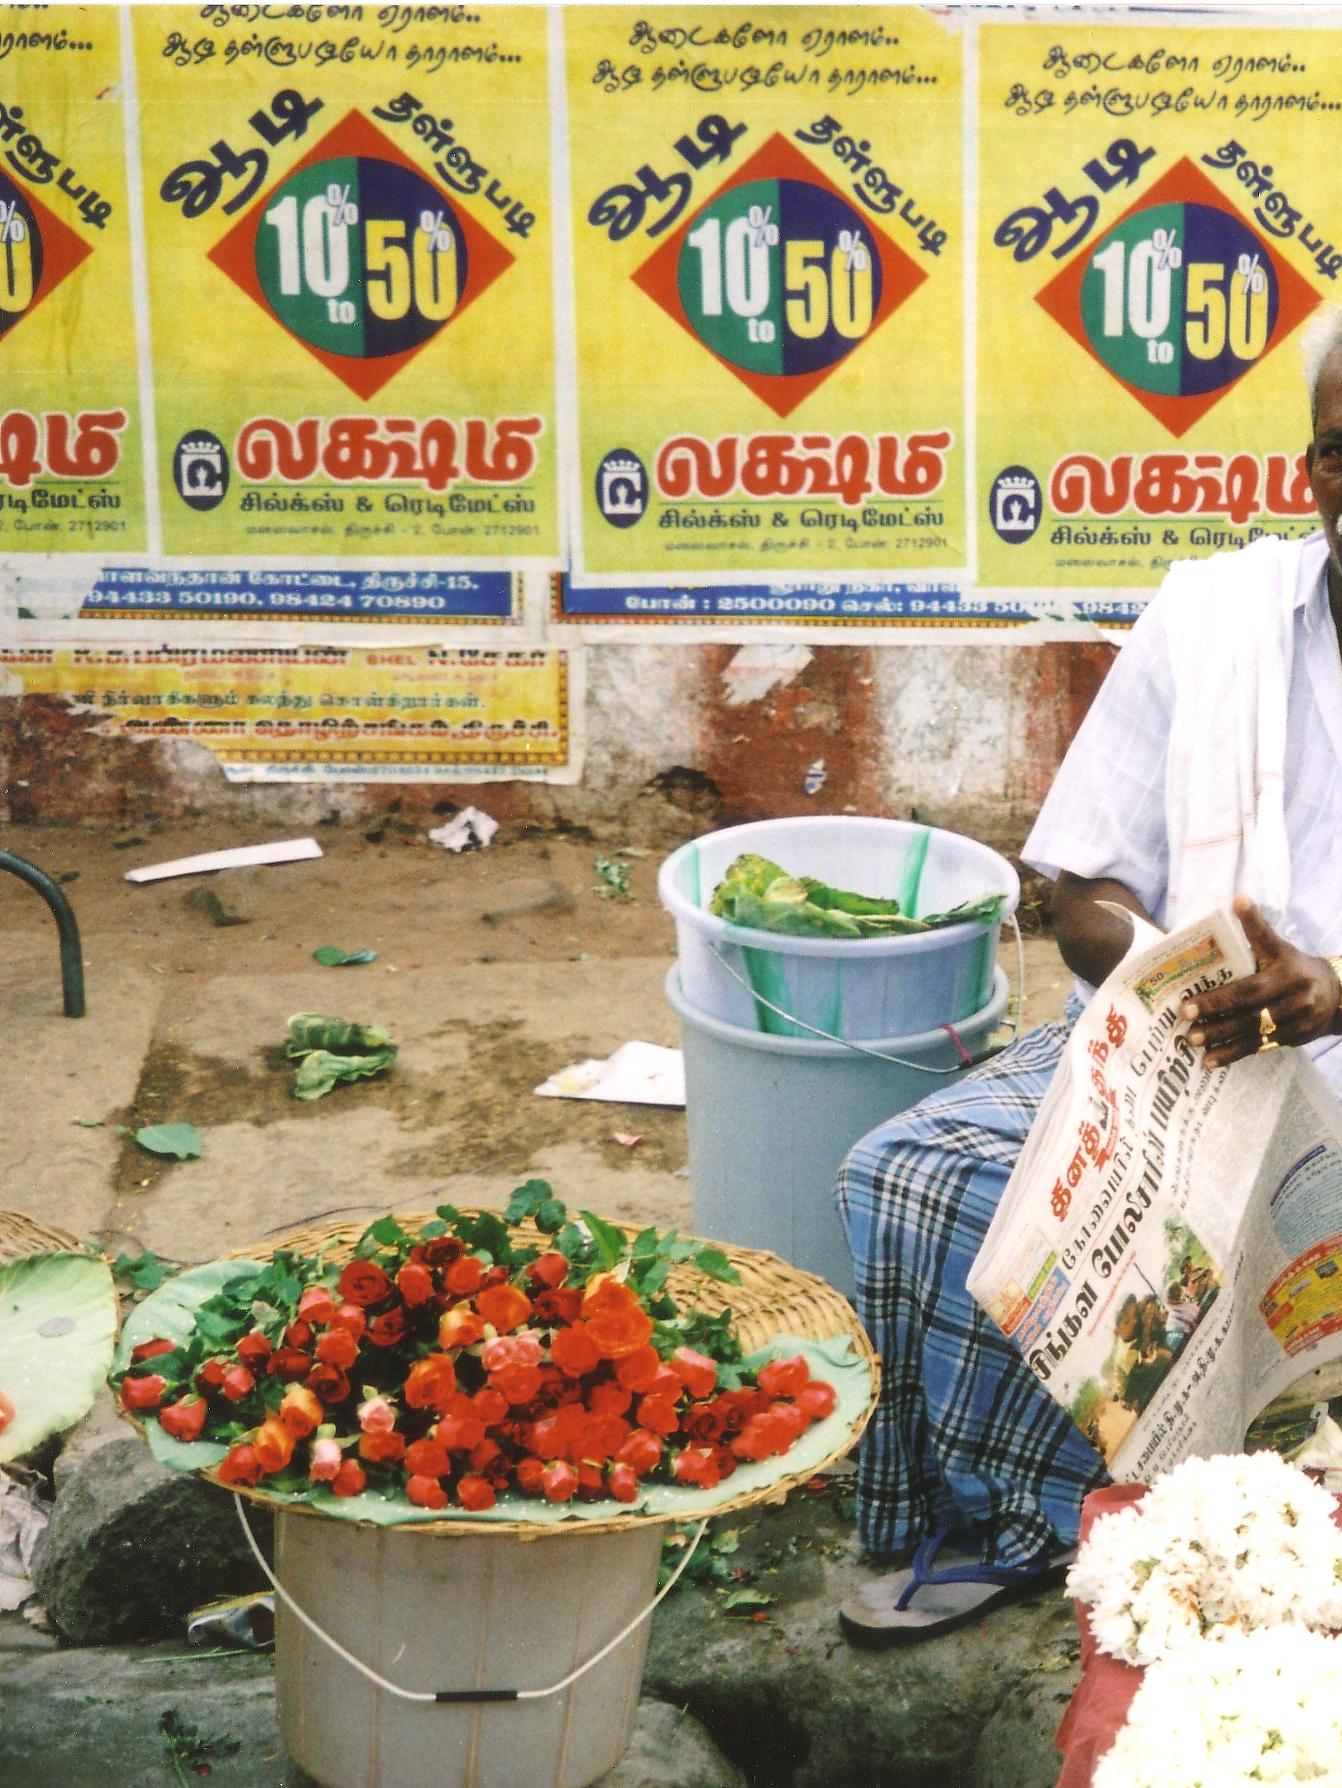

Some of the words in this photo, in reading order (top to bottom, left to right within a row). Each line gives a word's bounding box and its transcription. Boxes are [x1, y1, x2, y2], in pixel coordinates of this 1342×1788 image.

[162, 33, 216, 67] ஆடி
[629, 20, 787, 54] ஆடைகளோ
[592, 58, 643, 93] ஆடி
[1043, 45, 1198, 78] ஆடைகளோ
[1005, 83, 1055, 116] ஆடி
[160, 89, 325, 218] ஆடி
[372, 92, 536, 240] தள்ளுபடி
[588, 113, 748, 241] ஆடி
[794, 114, 947, 256] தள்ளுபடி
[993, 138, 1157, 263] ஆடி
[266, 184, 358, 298] 10%
[327, 298, 356, 324] to
[365, 210, 458, 321] 50%
[688, 205, 779, 317] 10%
[748, 318, 775, 342] to
[786, 230, 872, 339] 50%
[1093, 229, 1182, 333] 10%
[1147, 338, 1173, 363] to
[1186, 254, 1268, 360] 50%
[240, 492, 344, 513] சில்க்ஸ்
[356, 495, 372, 512] &
[384, 493, 536, 518] ரெடிமேட்ஸ்
[658, 508, 760, 529] சில்க்ஸ்
[772, 512, 789, 528] &
[800, 507, 944, 532] ரெடிமேட்ஸ்
[1050, 526, 1151, 546] சில்க்ஸ்
[1162, 530, 1179, 545] &
